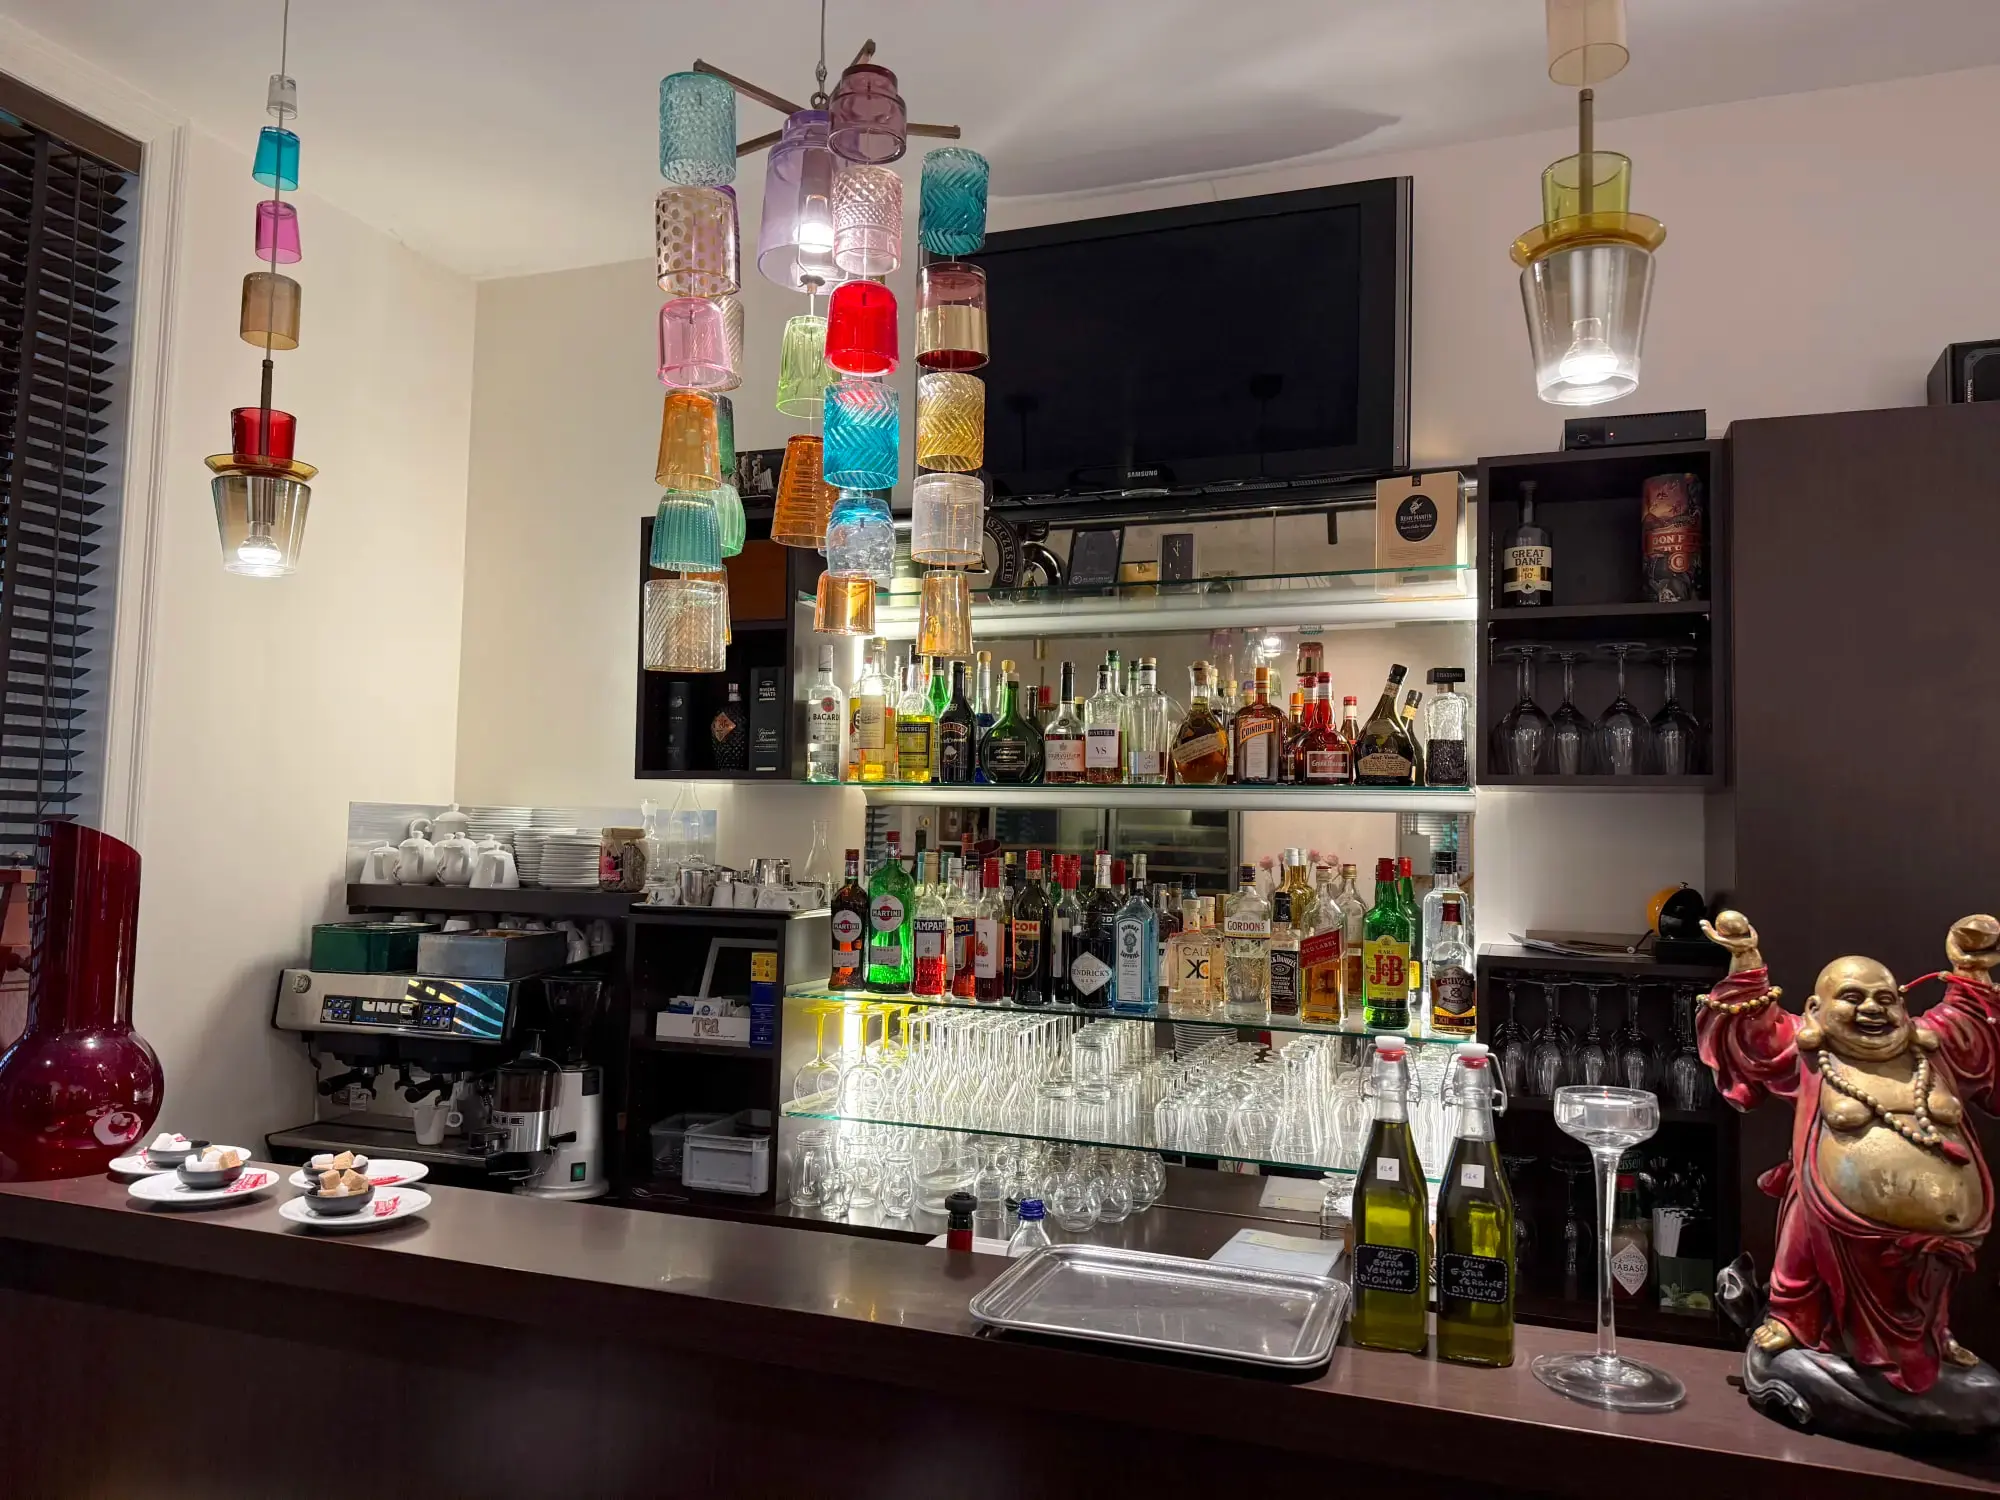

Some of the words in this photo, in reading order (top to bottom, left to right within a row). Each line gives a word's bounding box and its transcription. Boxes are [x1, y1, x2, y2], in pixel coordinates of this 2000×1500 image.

[1127, 469, 1158, 478] SAMSUNG
[1512, 549, 1545, 559] GREAT
[1515, 558, 1543, 566] DANE
[813, 713, 840, 721] BACARD
[1242, 722, 1272, 739] COINTREAU
[1095, 746, 1107, 755] VS
[872, 909, 902, 917] MARTINI
[1316, 940, 1337, 950] LABEL
[1440, 976, 1471, 986] CHIVAS
[692, 1016, 720, 1037] Tea
